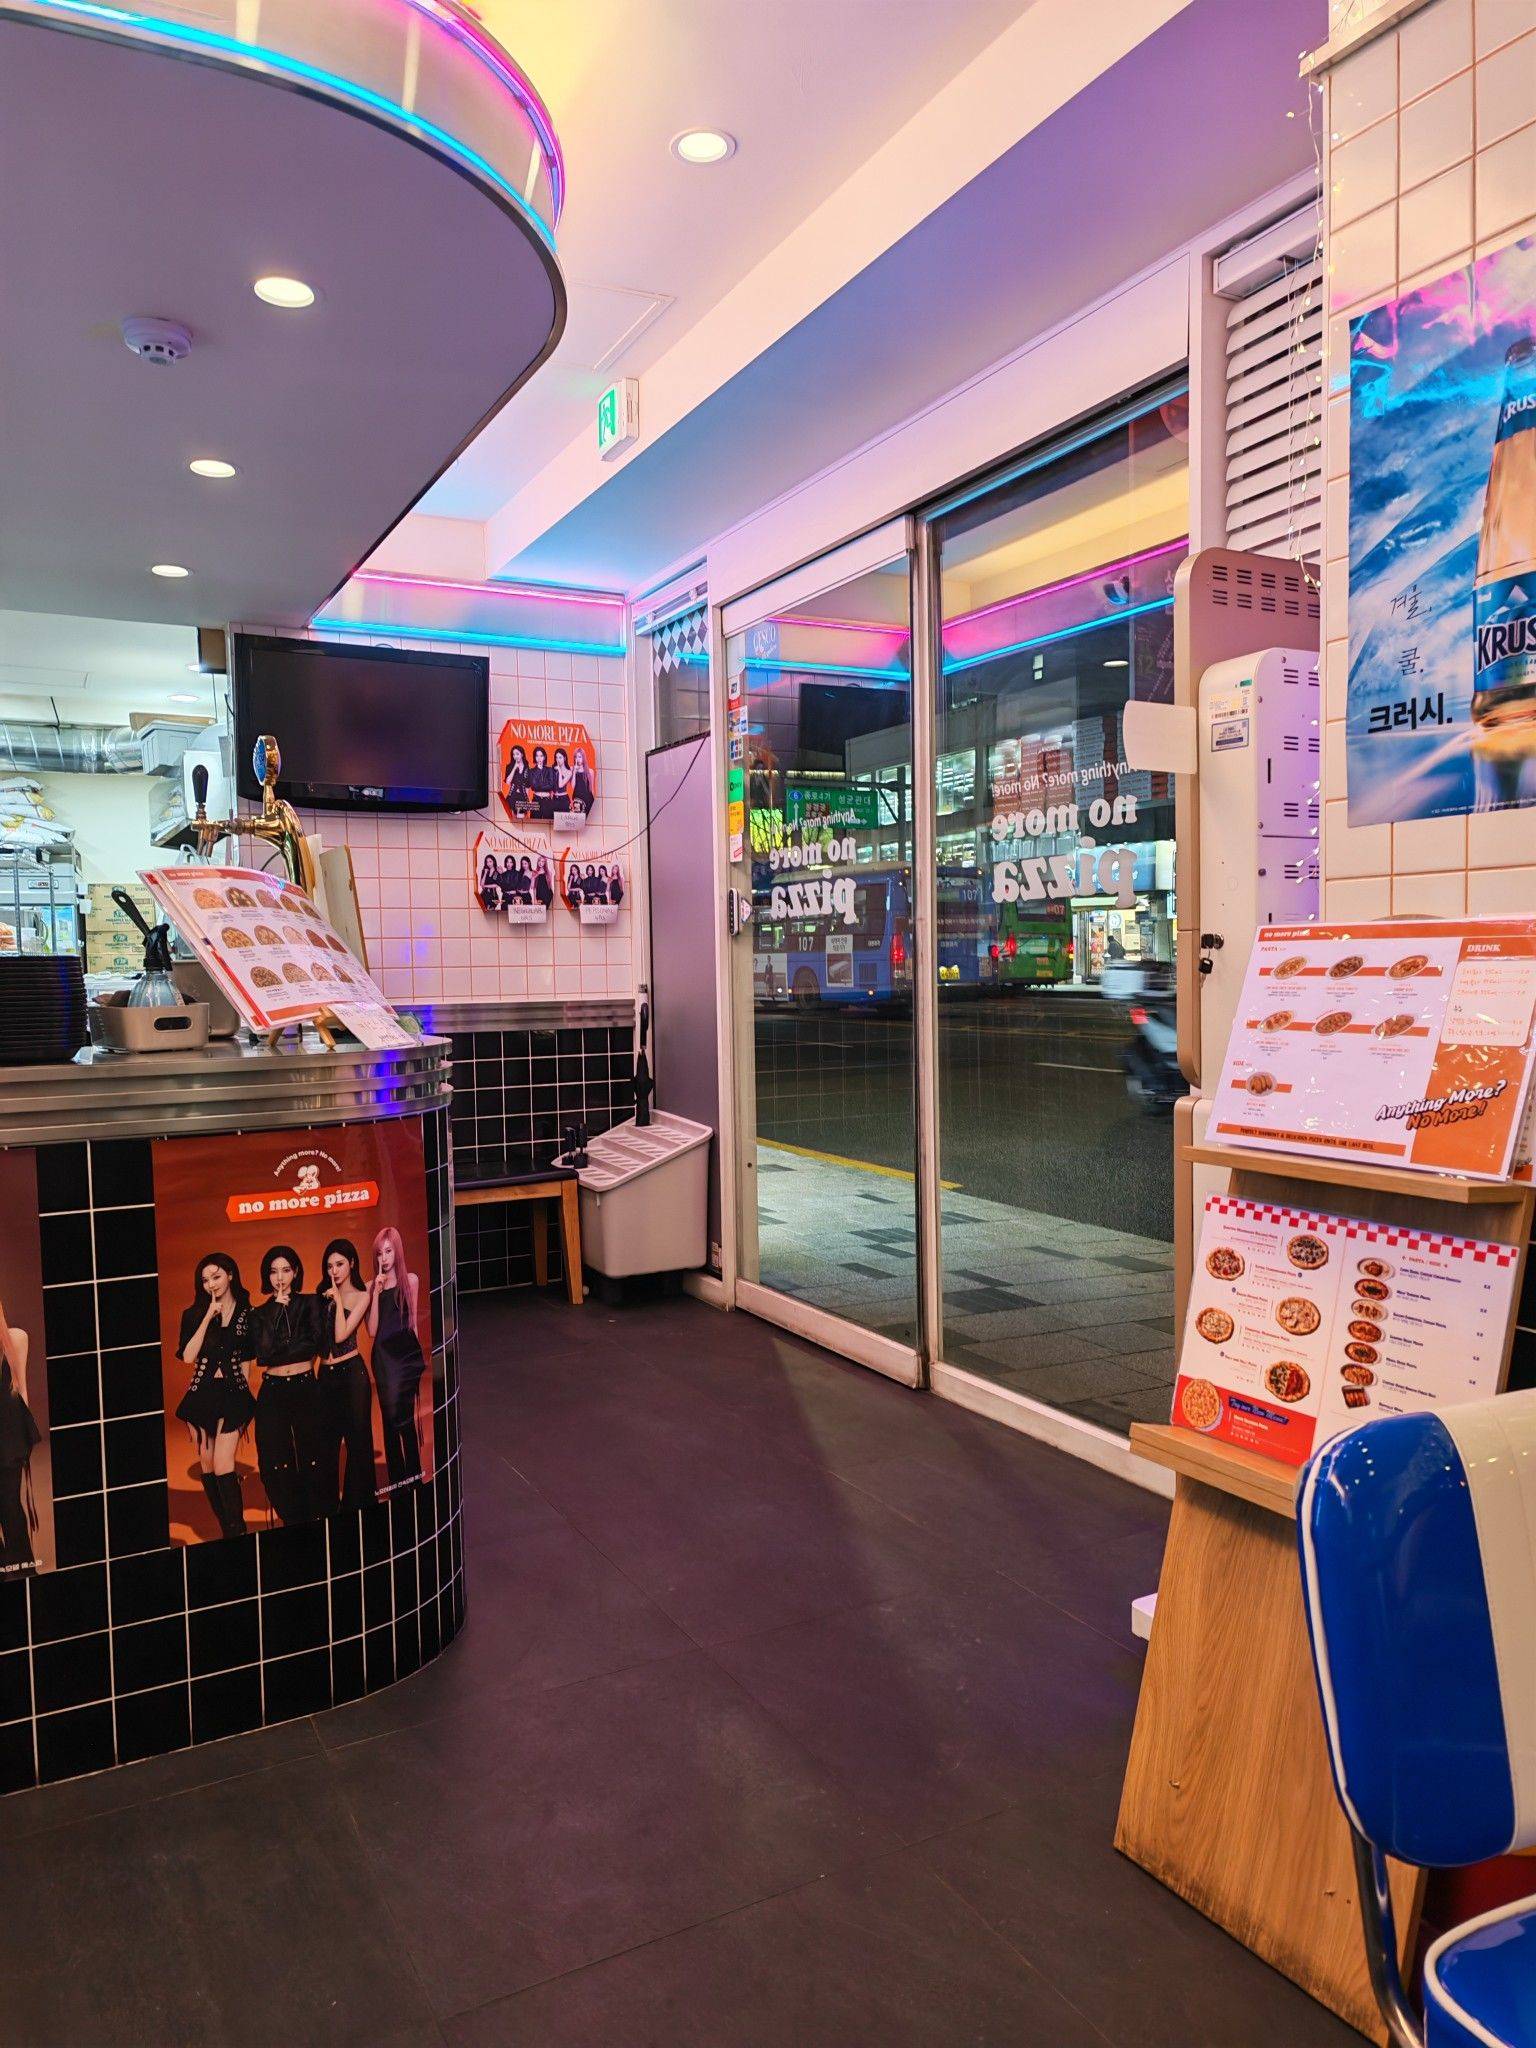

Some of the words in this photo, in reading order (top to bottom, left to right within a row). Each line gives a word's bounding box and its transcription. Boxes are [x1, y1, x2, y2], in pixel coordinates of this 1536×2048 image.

[1367, 692, 1453, 734] 크러시.
[510, 723, 526, 739] NO
[528, 724, 555, 741] MORE
[558, 726, 587, 744] PIZZA
[798, 936, 814, 952] 107
[1466, 944, 1501, 952] DRINK
[1375, 1098, 1446, 1122] Anything
[1448, 1079, 1508, 1104] More?
[1433, 1101, 1488, 1127] More!
[273, 1152, 298, 1177] Anything
[298, 1149, 319, 1157] more?
[319, 1150, 328, 1159] No
[327, 1156, 342, 1173] more!
[238, 1201, 265, 1215] no
[269, 1196, 320, 1212] more
[324, 1188, 370, 1209] pizza
